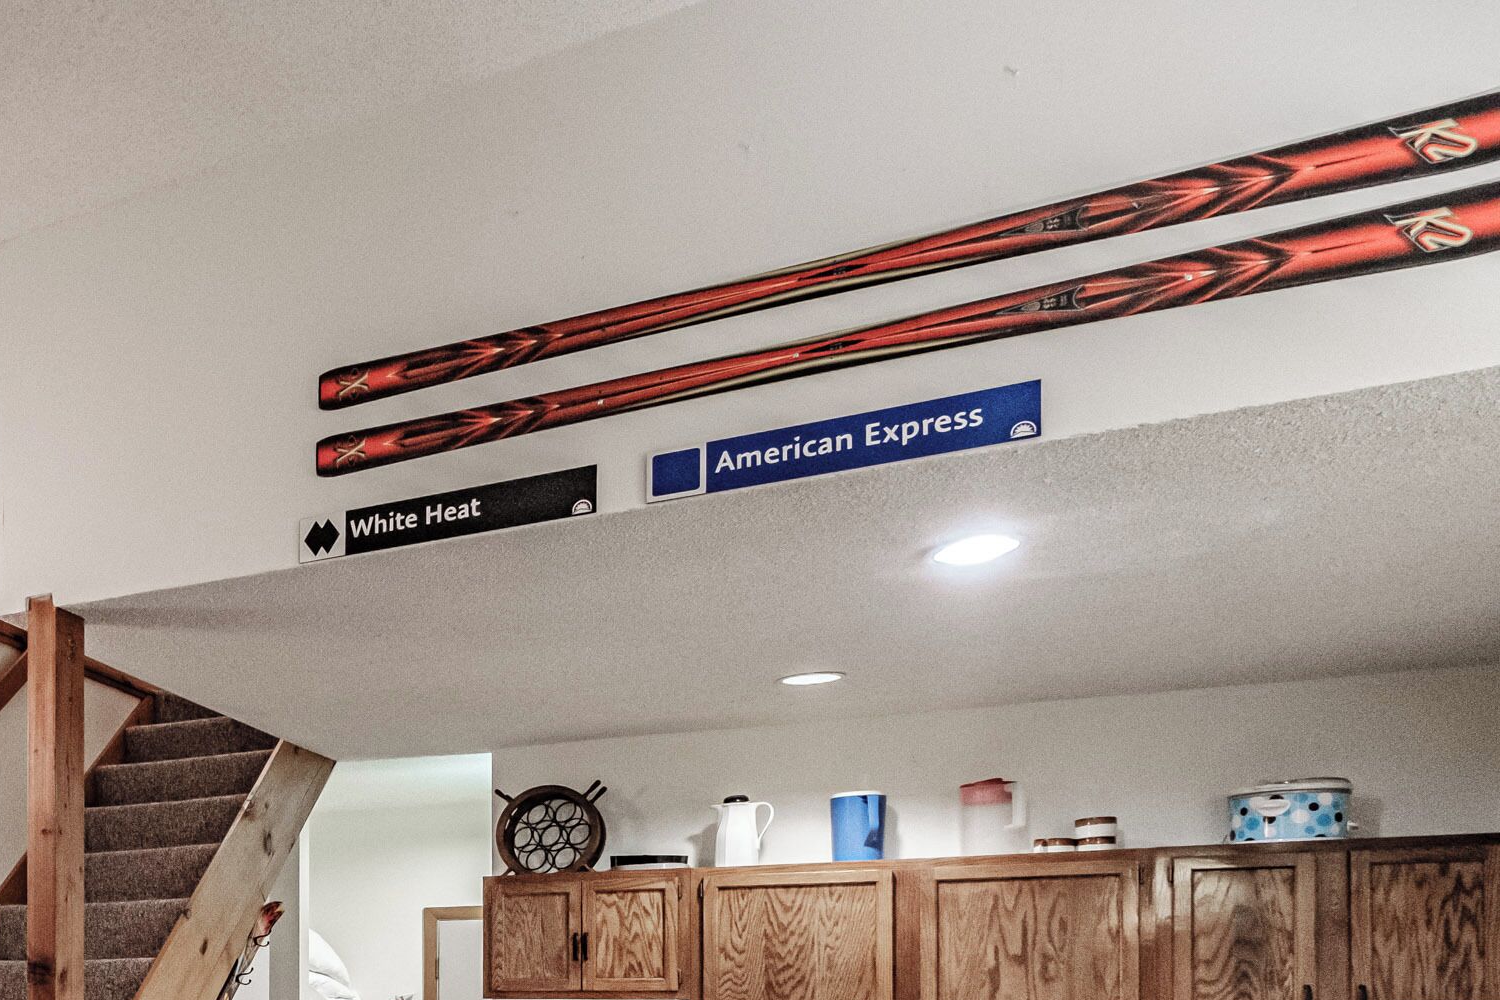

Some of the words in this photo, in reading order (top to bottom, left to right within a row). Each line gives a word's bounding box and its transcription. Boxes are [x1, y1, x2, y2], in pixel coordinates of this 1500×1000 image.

[1387, 118, 1477, 164] K2
[1383, 207, 1472, 253] K2
[715, 431, 853, 474] American
[865, 408, 984, 447] Express
[350, 511, 418, 539] White
[425, 498, 482, 525] Heat
